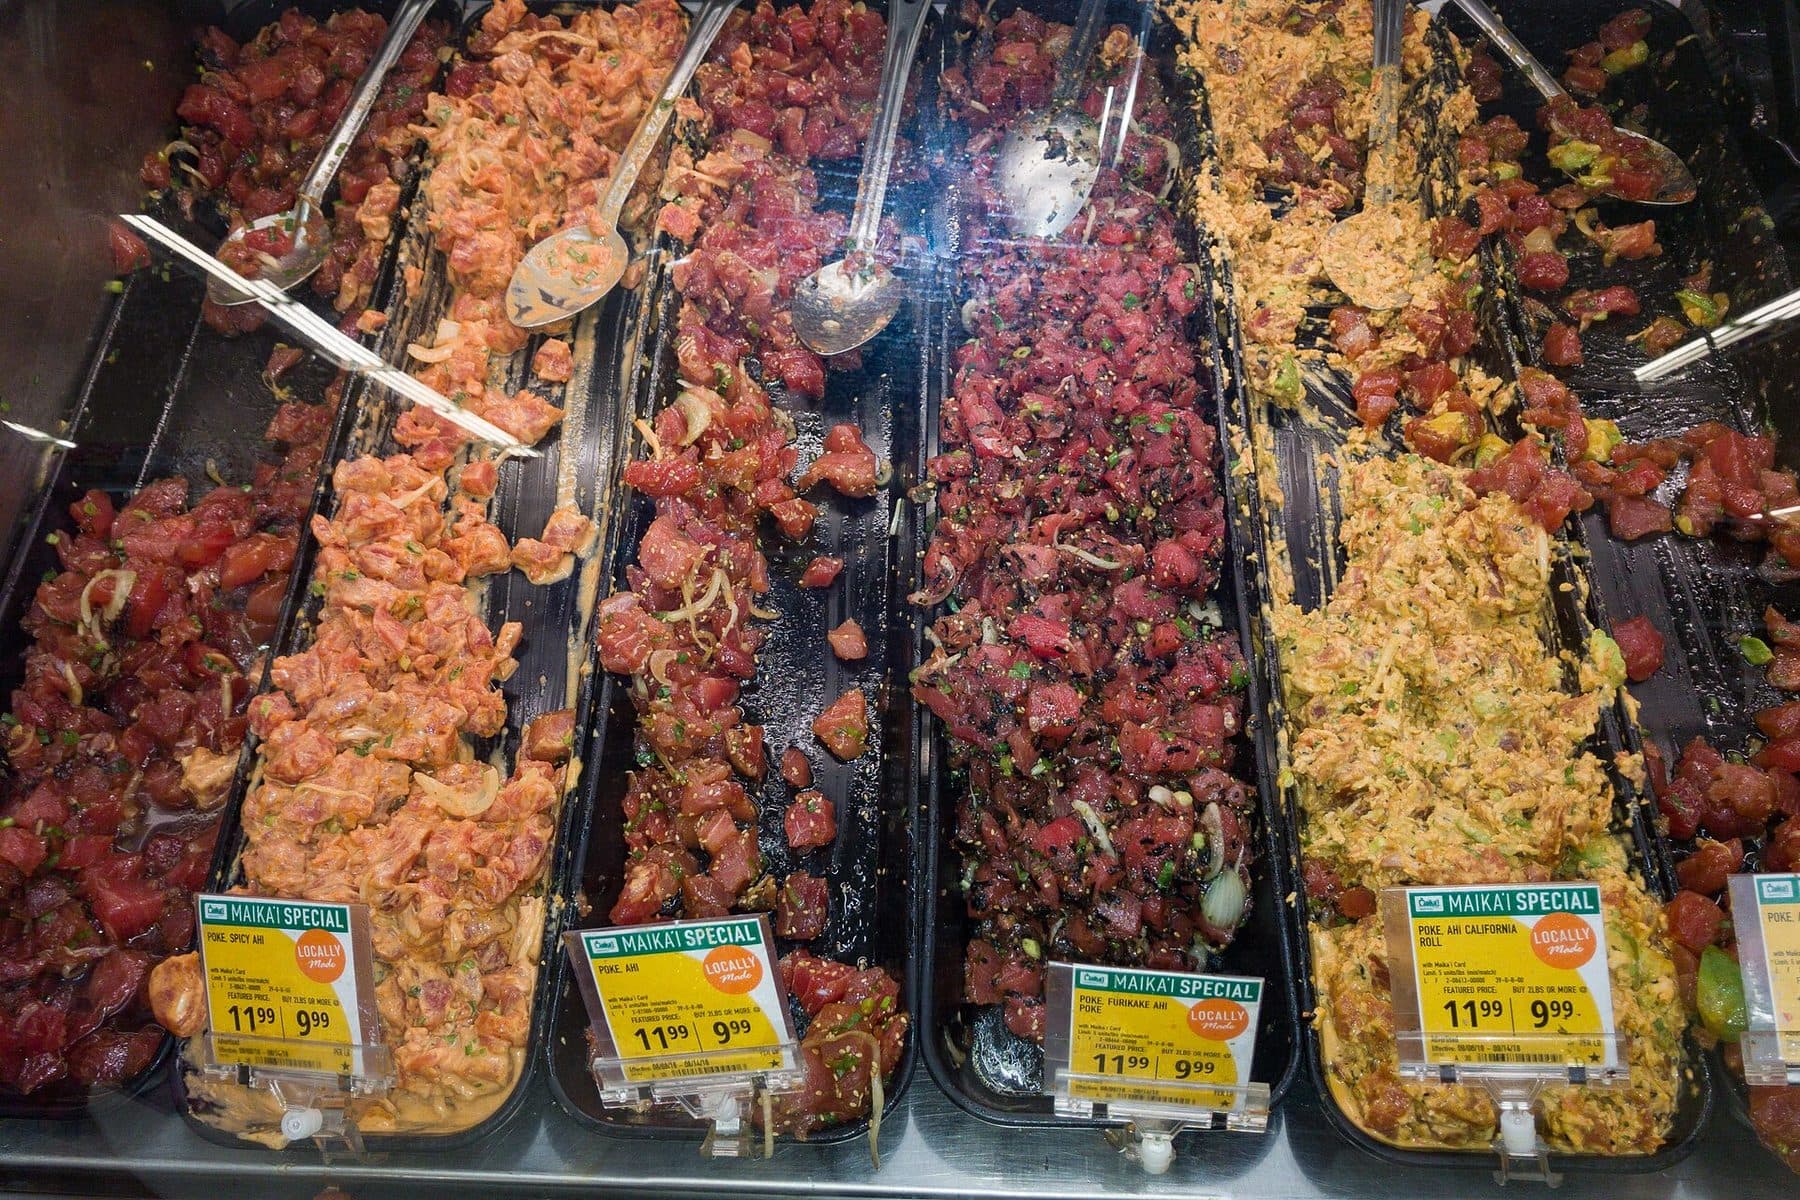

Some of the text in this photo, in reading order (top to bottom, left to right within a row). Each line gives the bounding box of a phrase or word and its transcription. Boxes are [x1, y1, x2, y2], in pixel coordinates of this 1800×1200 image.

[1516, 891, 1594, 911] SPECIAL
[284, 907, 344, 928] SPECIAL
[1447, 925, 1461, 935] AHI
[1465, 924, 1518, 935] CALIFORNIA
[229, 934, 250, 944] SPICY
[252, 935, 265, 945] AHI
[684, 926, 756, 947] SPECIAL
[1420, 936, 1442, 947] ROLL
[1534, 927, 1591, 945] LOCALLY
[298, 945, 341, 958] LOCALLY
[1547, 944, 1584, 955] Made
[308, 960, 336, 969] Made
[625, 963, 640, 973] AHI
[705, 956, 756, 975] LOCALLY
[720, 972, 752, 983] Made
[1180, 979, 1253, 999] SPECIAL
[1443, 986, 1474, 994] FEATURED
[1512, 986, 1576, 994] BUY 2LBS OR MORE
[228, 992, 252, 1000] FEATURED
[317, 998, 331, 1006] MORE
[1108, 998, 1150, 1008] FURIKAKE
[1153, 1001, 1168, 1010] AHI
[1079, 1004, 1102, 1014] POKE
[631, 1015, 660, 1024] FEATURED
[1191, 1010, 1245, 1021] LOCALLY
[1202, 1022, 1236, 1030] Made
[1095, 1043, 1125, 1051] FEATURED
